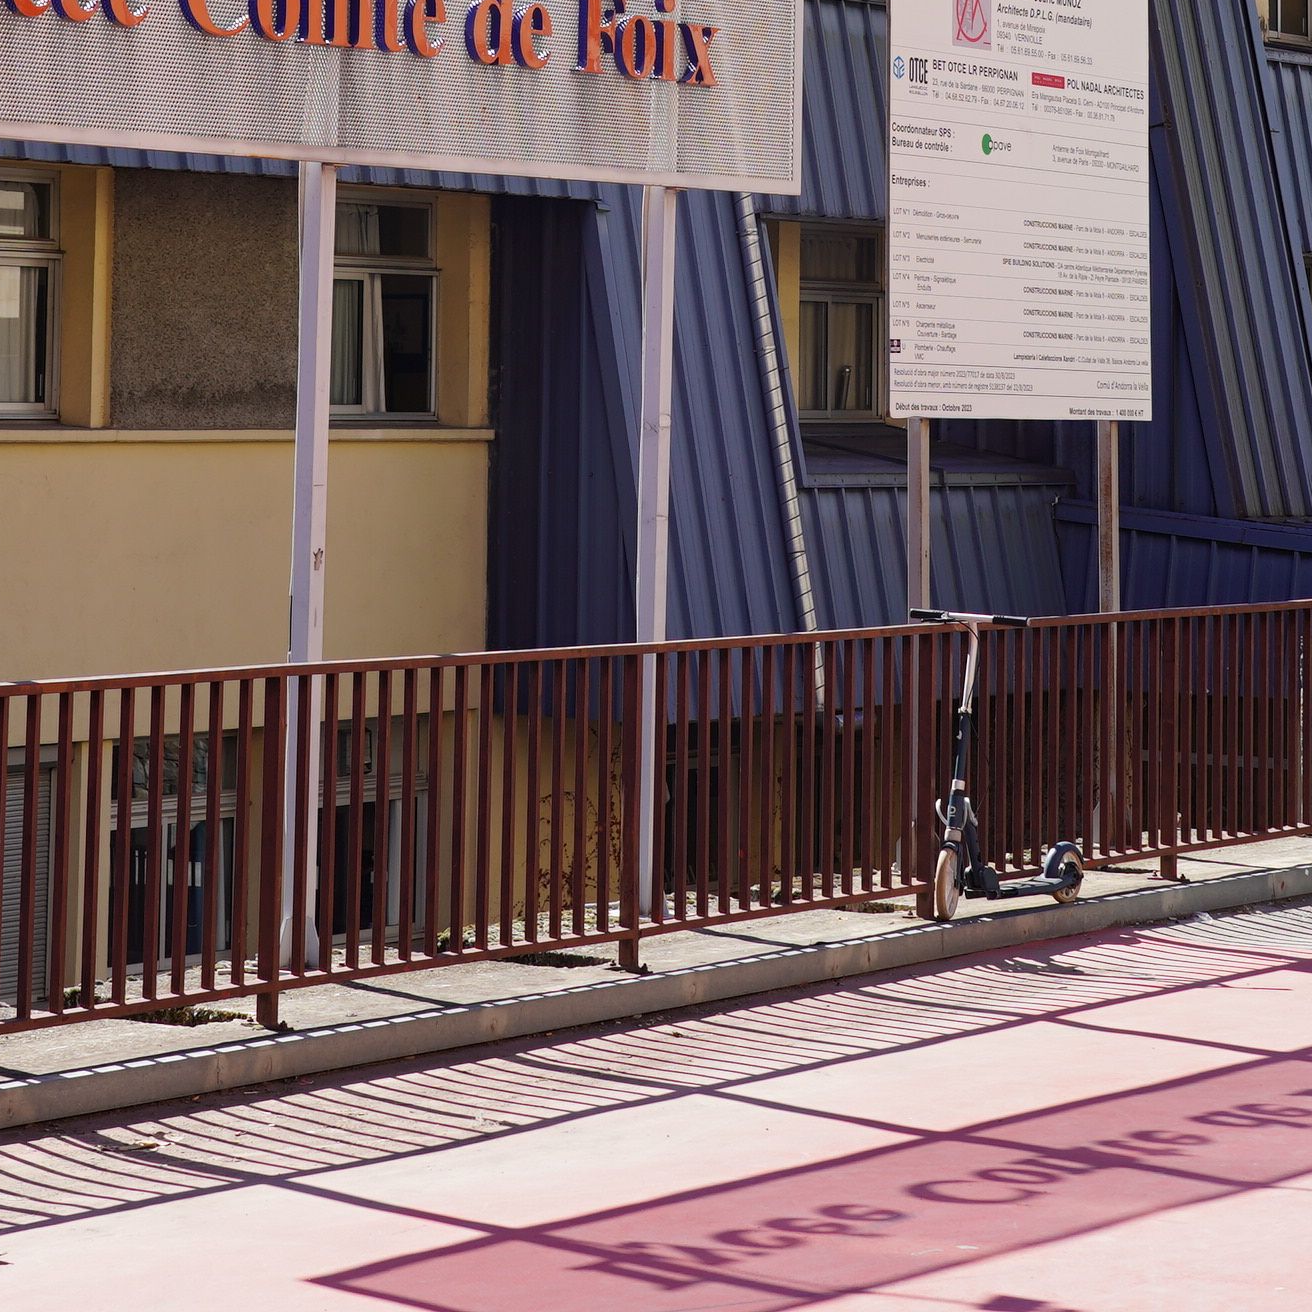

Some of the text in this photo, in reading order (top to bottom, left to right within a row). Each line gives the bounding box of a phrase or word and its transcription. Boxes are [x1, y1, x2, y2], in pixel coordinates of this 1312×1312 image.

[997, 3, 1091, 29] Architecte D.P.L.G. (mandataire)
[909, 57, 927, 84] OTCE
[932, 59, 1017, 81] BET OTCE LR PERPIGNAN
[1067, 79, 1078, 89] POL
[1081, 81, 1101, 93] NADAL
[1104, 84, 1144, 100] ARCHITECTES
[891, 122, 951, 138] Coordonnateur SPS
[891, 137, 949, 152] Bureau de contrôle
[988, 140, 1011, 152] apave
[891, 174, 926, 189] Entreprises
[895, 402, 909, 411] Début
[942, 404, 960, 412] Octobre
[961, 404, 972, 412] 2023
